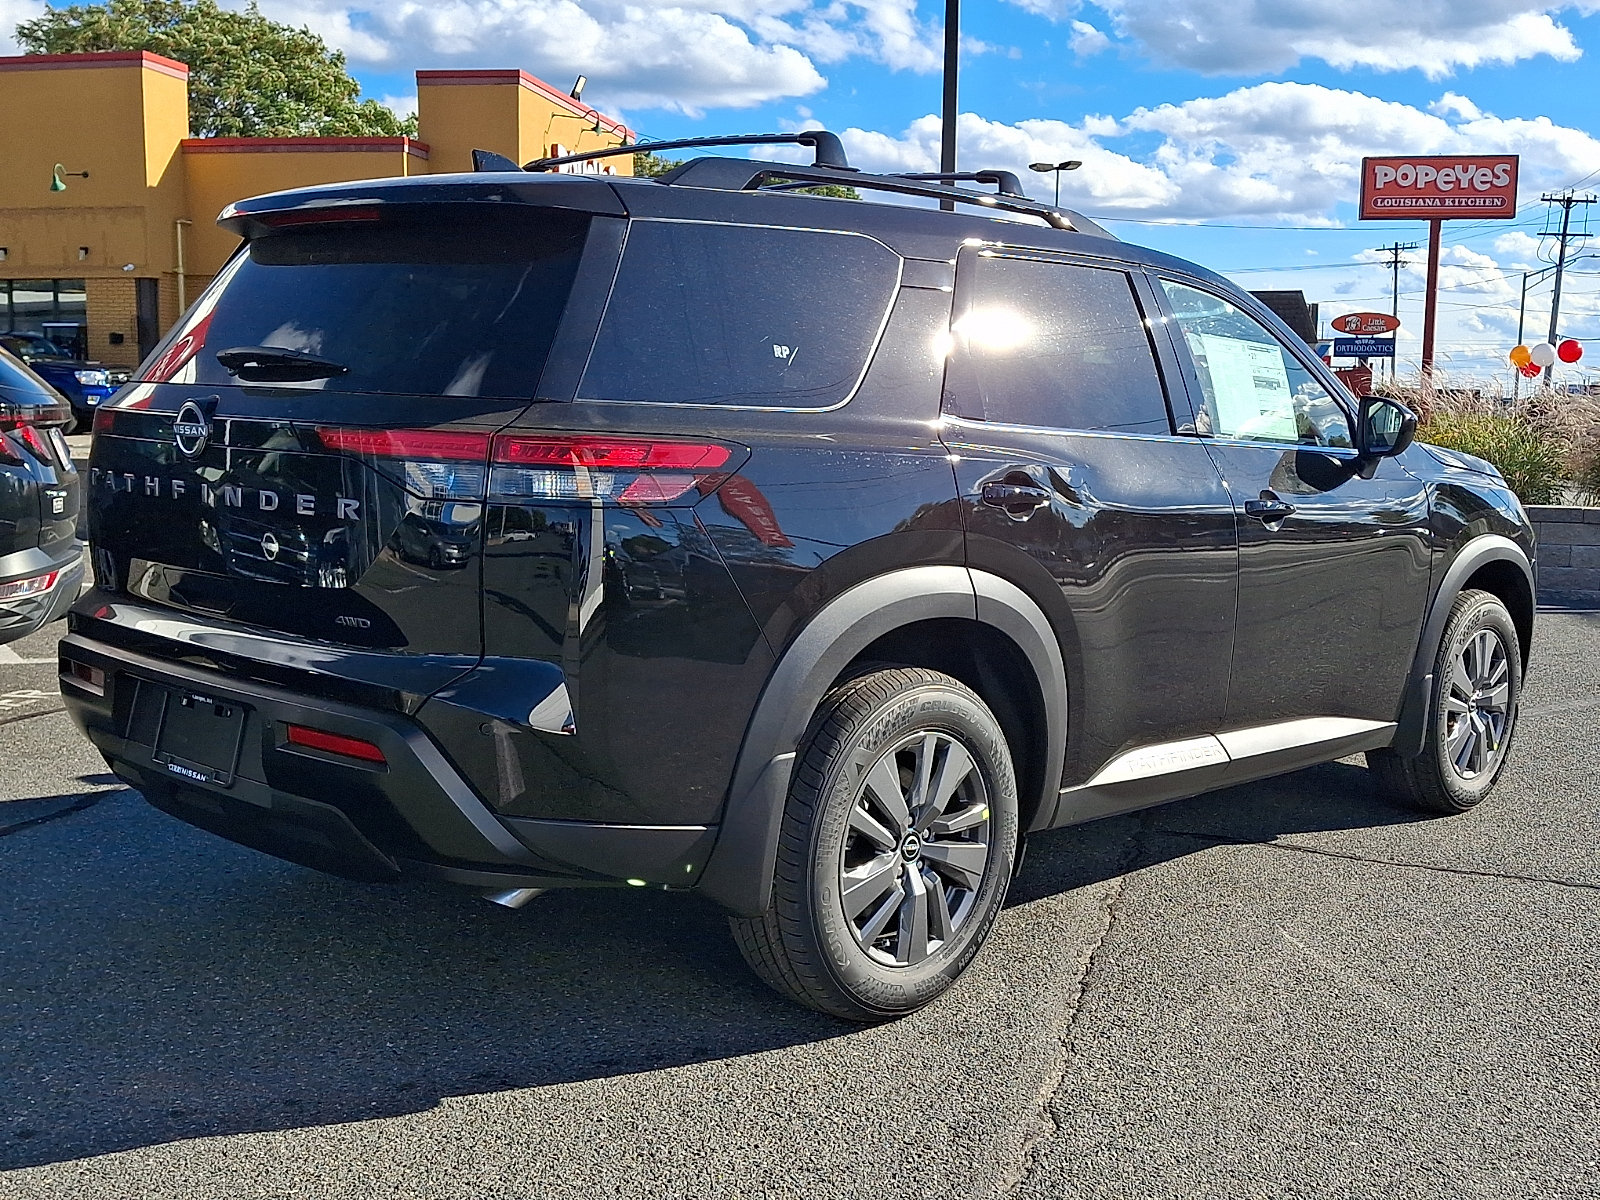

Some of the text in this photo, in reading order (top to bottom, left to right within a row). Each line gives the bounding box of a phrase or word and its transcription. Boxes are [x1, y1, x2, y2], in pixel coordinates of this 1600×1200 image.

[1376, 197, 1503, 207] LOUISIANA KITCHEN
[1368, 318, 1386, 326] Little
[1362, 324, 1387, 332] Caesars
[1335, 344, 1394, 353] ORTHODONTICS
[173, 424, 206, 436] NISSAN
[90, 467, 361, 521] PATHFINDER
[335, 615, 371, 629] 4WD
[821, 886, 851, 972] KUMHO
